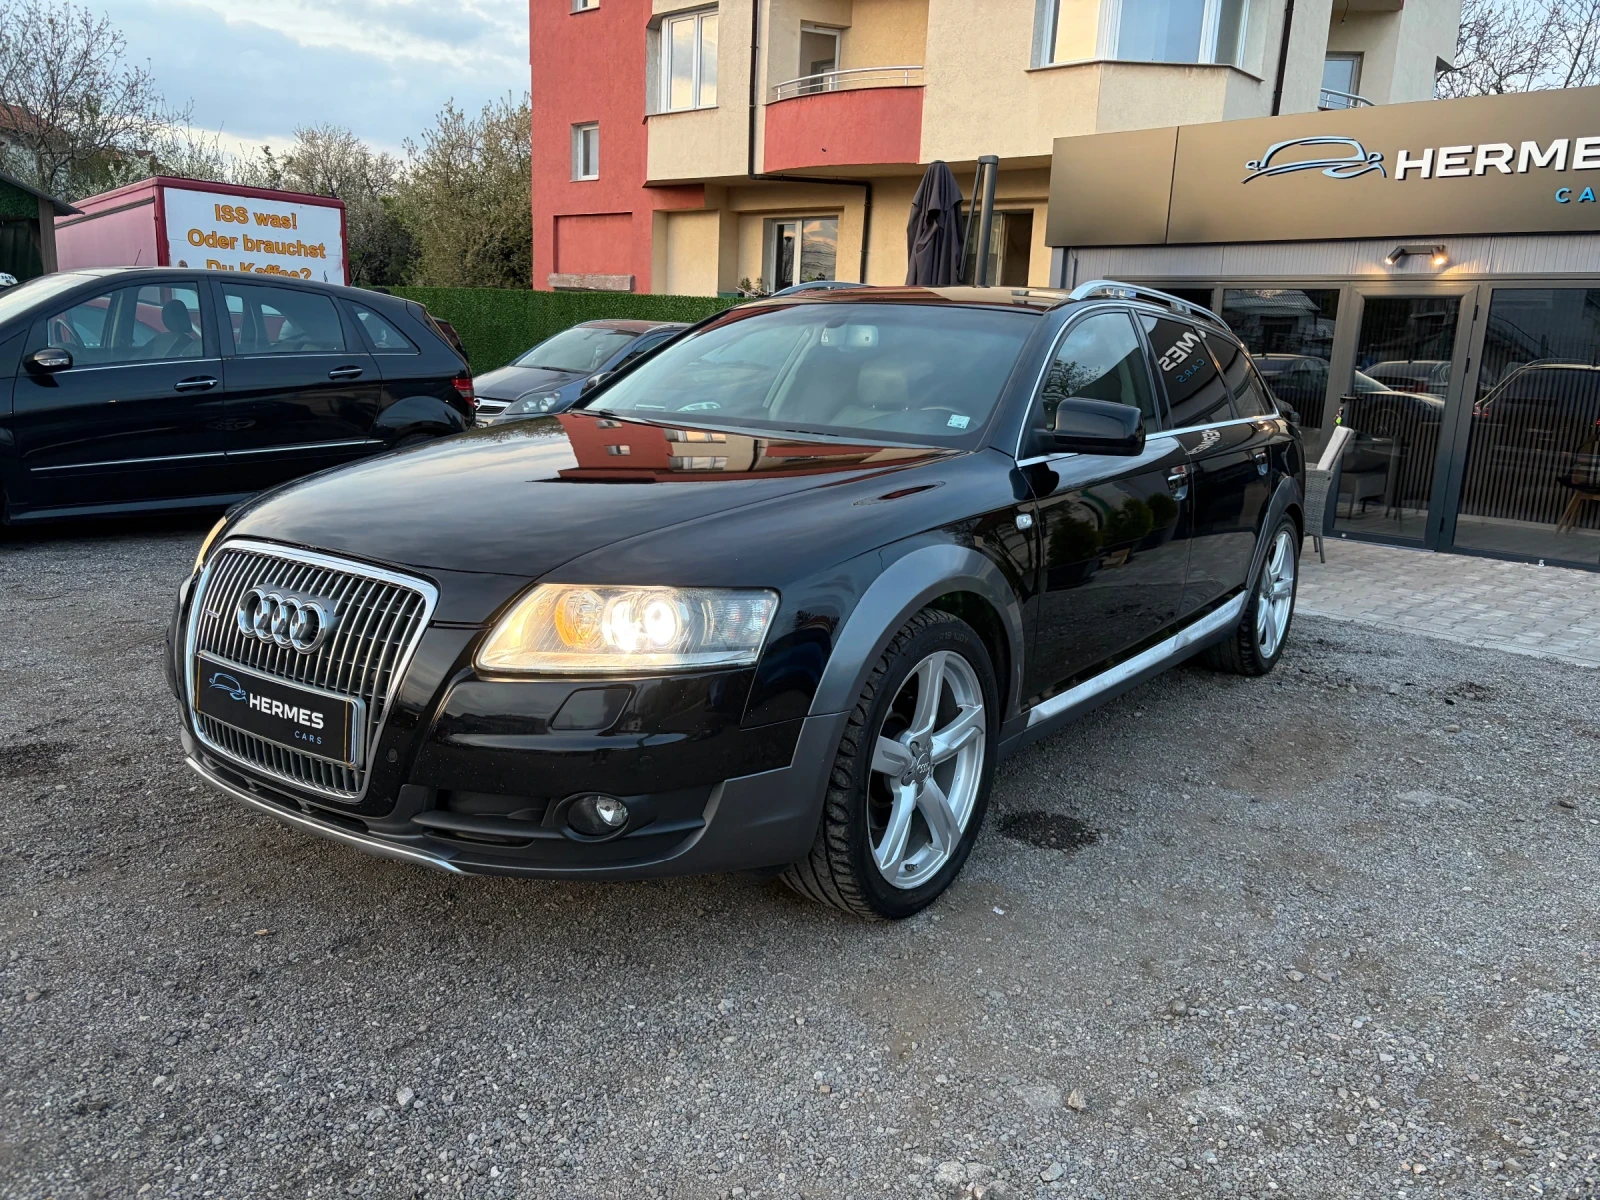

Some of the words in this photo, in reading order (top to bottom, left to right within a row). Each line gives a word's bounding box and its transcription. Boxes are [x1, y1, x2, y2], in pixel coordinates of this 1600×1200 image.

[214, 203, 249, 224] ISS
[253, 212, 298, 230] was!
[187, 228, 238, 250] Oder
[243, 234, 327, 259] brauchst
[249, 692, 324, 730] HERMES
[294, 730, 323, 745] CARS
